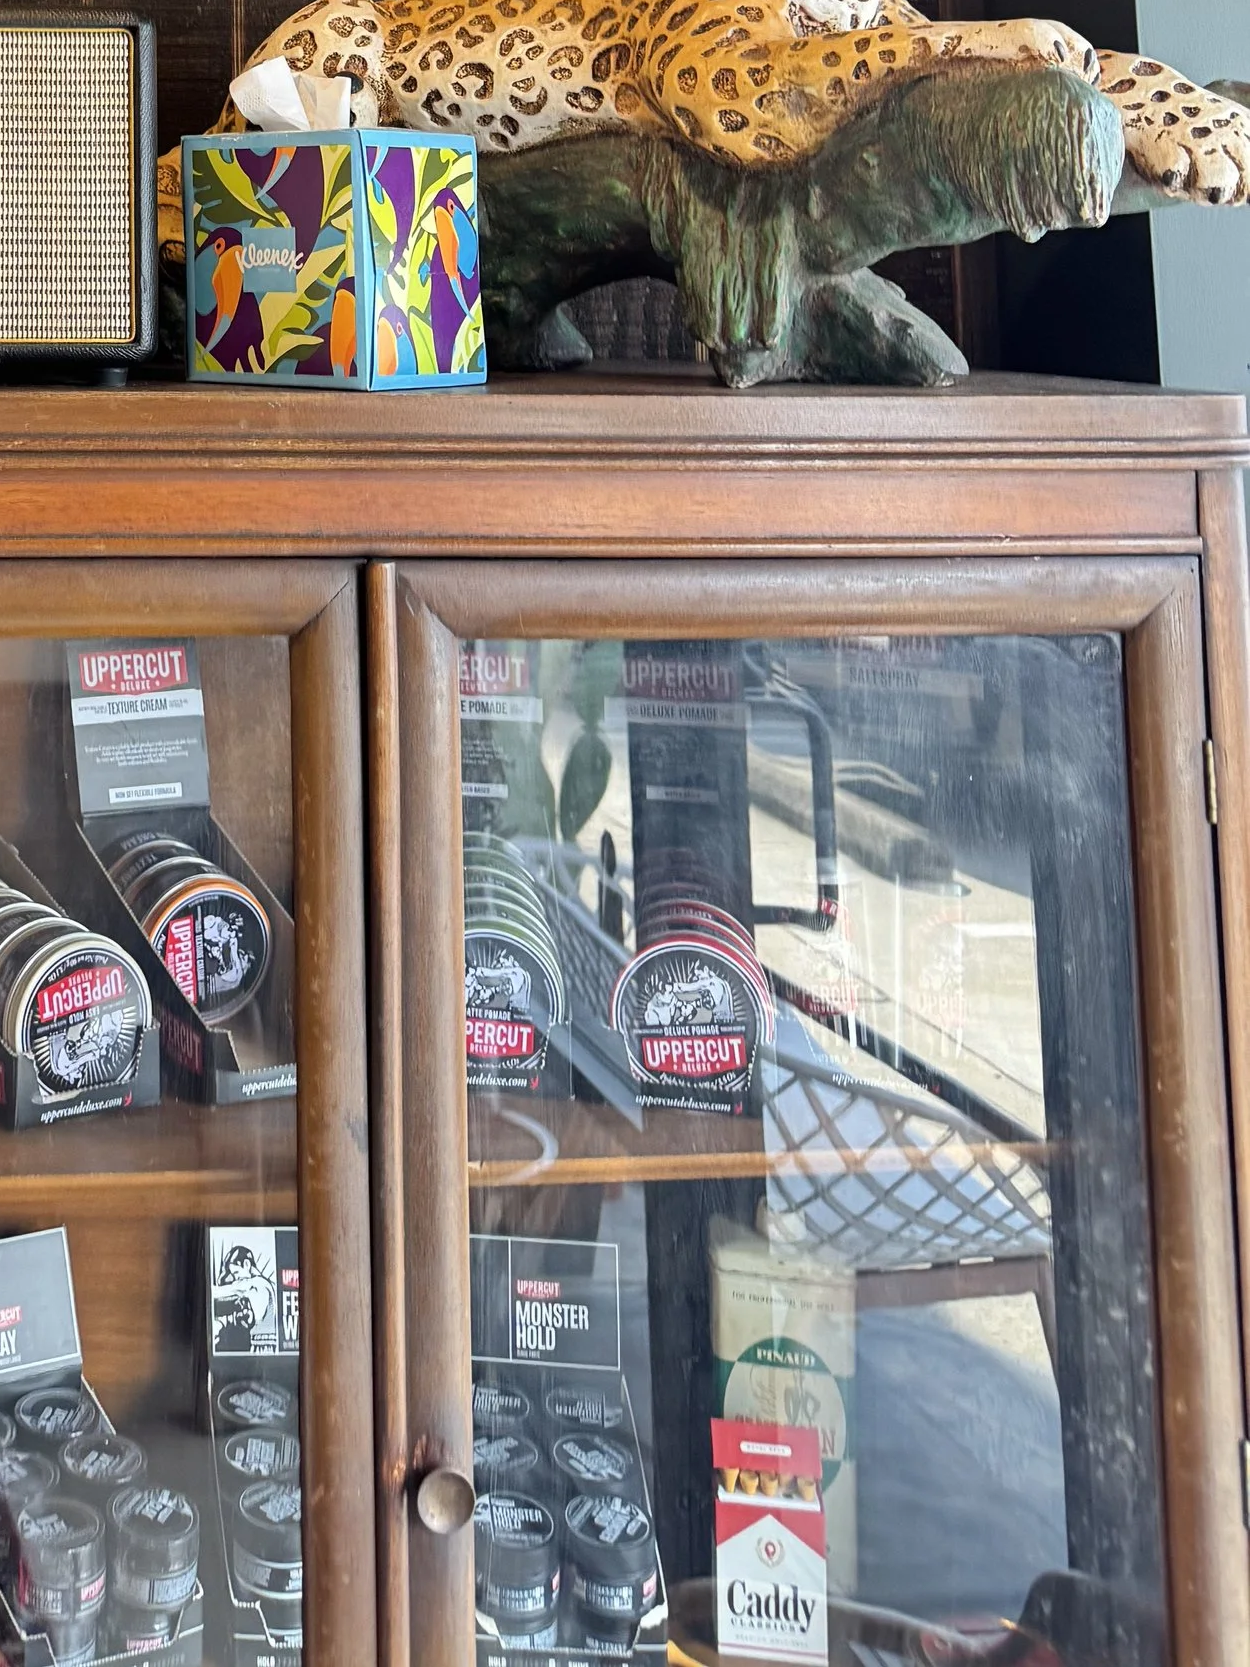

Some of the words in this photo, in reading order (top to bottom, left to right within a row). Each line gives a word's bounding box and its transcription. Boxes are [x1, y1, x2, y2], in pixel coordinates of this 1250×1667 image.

[235, 243, 304, 275] Kleenex
[82, 650, 183, 687] UPPERCUT
[461, 655, 526, 688] ERCUT
[623, 659, 732, 694] UPPERCUT
[121, 680, 151, 692] DELUXE
[107, 701, 139, 716] TEXTURE
[140, 698, 168, 712] CREAM
[468, 700, 508, 715] POMADE
[640, 704, 674, 718] DELUXE
[678, 705, 717, 721] POMADE
[68, 971, 93, 986] DELUXE
[43, 969, 123, 1020] UPPERCUT
[68, 1010, 84, 1024] HOLD
[85, 1006, 100, 1016] EASY
[466, 1009, 483, 1021] ATTE
[484, 1009, 511, 1022] POMADE
[466, 1019, 532, 1053] PERCUT
[664, 1026, 690, 1036] DELUXE
[691, 1025, 720, 1035] POMADE
[470, 1044, 498, 1055] DELUXE
[645, 1038, 742, 1068] UPPERCUT
[682, 1062, 711, 1073] DELUXE
[242, 1072, 297, 1096] uppercutdelu
[40, 1095, 123, 1123] uppercutdeluxe.com
[635, 1095, 732, 1112] uppercutdeluxe.com
[517, 1279, 560, 1297] UPPERCUT
[282, 1291, 299, 1316] FE
[516, 1300, 589, 1330] MONSTER
[282, 1315, 299, 1340] W
[516, 1325, 556, 1351] HOLD
[756, 1348, 816, 1368] PINAUD
[494, 1507, 543, 1524] MONSTER
[494, 1516, 522, 1530] HOLD
[727, 1578, 816, 1634] Caddy
